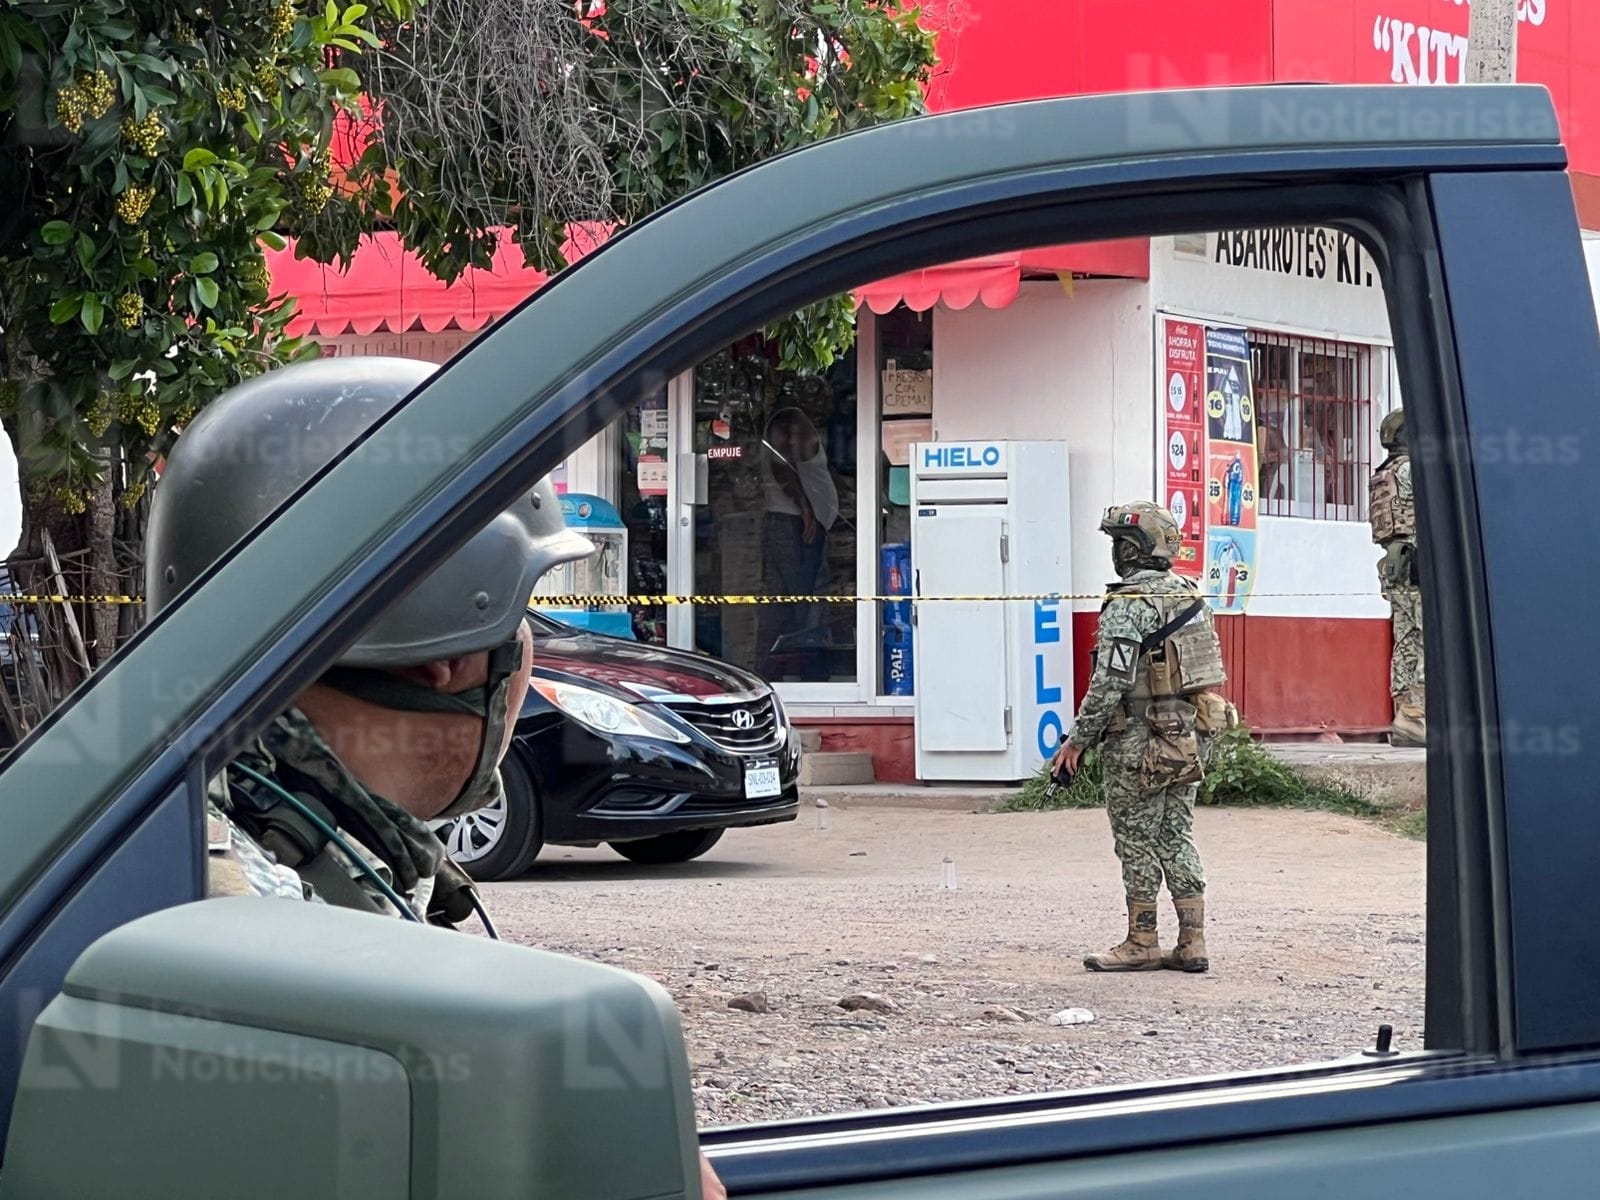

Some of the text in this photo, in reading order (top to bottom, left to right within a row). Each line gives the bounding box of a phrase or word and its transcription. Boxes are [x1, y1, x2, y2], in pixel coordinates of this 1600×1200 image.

[1168, 348, 1197, 361] DISFRUTA
[708, 446, 742, 459] EMPUJE
[924, 446, 1000, 468] HIELO
